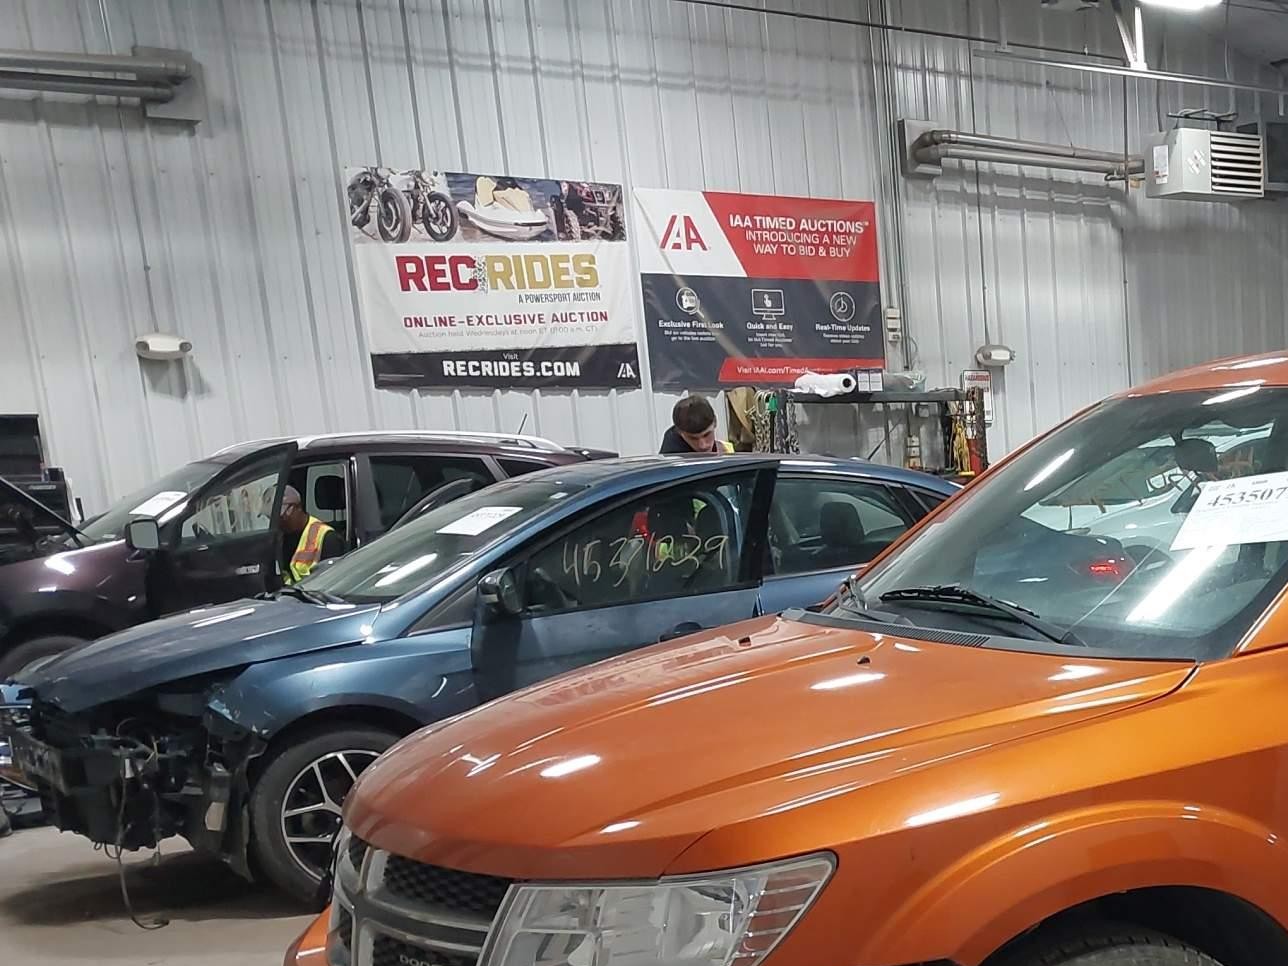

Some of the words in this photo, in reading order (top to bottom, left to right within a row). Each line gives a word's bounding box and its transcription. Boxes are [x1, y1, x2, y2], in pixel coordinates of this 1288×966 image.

[729, 214, 752, 228] IAA
[754, 216, 796, 230] TIMED
[745, 230, 819, 244] INTRODUCING
[822, 235, 830, 244] A
[833, 235, 857, 246] NEW
[753, 243, 778, 255] WAY
[780, 244, 796, 255] TO
[799, 246, 816, 256] BID
[818, 246, 827, 256] &
[830, 247, 851, 257] BUY
[395, 255, 479, 291] REC
[486, 254, 600, 290] RIDES
[525, 293, 570, 303] POWERSPORT
[572, 292, 601, 302] AUCTION
[403, 315, 546, 329] ONLINE-EXCLUSIVE
[551, 311, 608, 324] AUCTION
[658, 320, 691, 328] Exclusive
[746, 322, 764, 331] Quick
[779, 323, 793, 331] Easy
[815, 323, 846, 331] Real-Time
[847, 324, 871, 332] Updates
[443, 361, 580, 377] RECRIDES.COM
[737, 365, 752, 374] Visit
